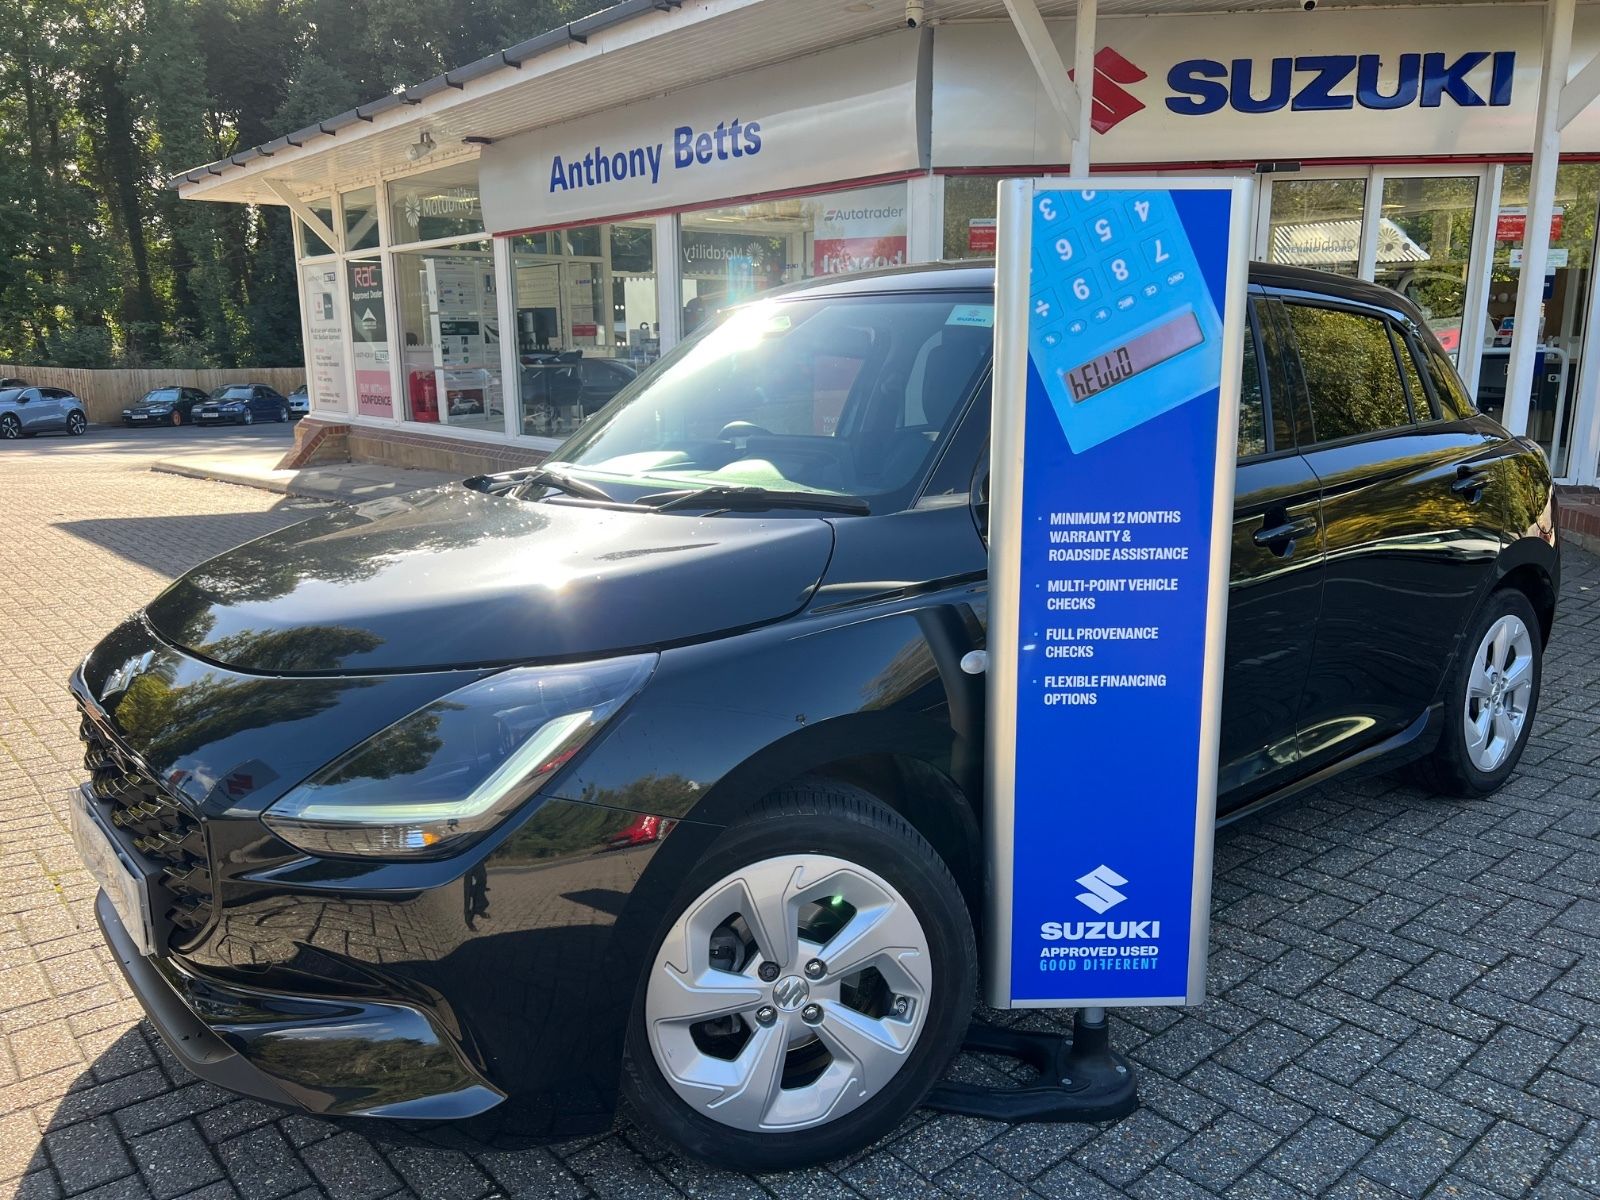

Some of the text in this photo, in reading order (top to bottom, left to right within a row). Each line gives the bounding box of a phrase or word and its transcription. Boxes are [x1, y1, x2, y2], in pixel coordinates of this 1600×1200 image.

[1165, 51, 1516, 115] SUZUKI
[550, 118, 762, 192] Anthony Betts
[834, 206, 904, 221] Autotrader
[1039, 198, 1056, 220] 3
[1134, 200, 1149, 222] 4
[1095, 219, 1112, 242] 5
[1155, 239, 1169, 263] 7
[1111, 259, 1128, 281] 8
[1050, 510, 1181, 525] MINIMUM 12 MONTHS
[1050, 529, 1131, 543] WARRANTY &
[1049, 547, 1189, 561] ROADSIDE ASSISTANCE
[1047, 578, 1178, 592] MULTI-POINT VEHICLE
[1047, 597, 1096, 610] CHECKS
[1046, 627, 1158, 641] FULL PROVENANCE
[1045, 645, 1094, 658] CHECKS
[1044, 674, 1167, 688] FLEXIBLE FINANCING
[1044, 693, 1097, 705] OPTIONS
[1040, 920, 1160, 940] SUZUKI
[1040, 945, 1159, 958] APPROVED USED
[1040, 957, 1158, 971] GOOD DIFFERENT
